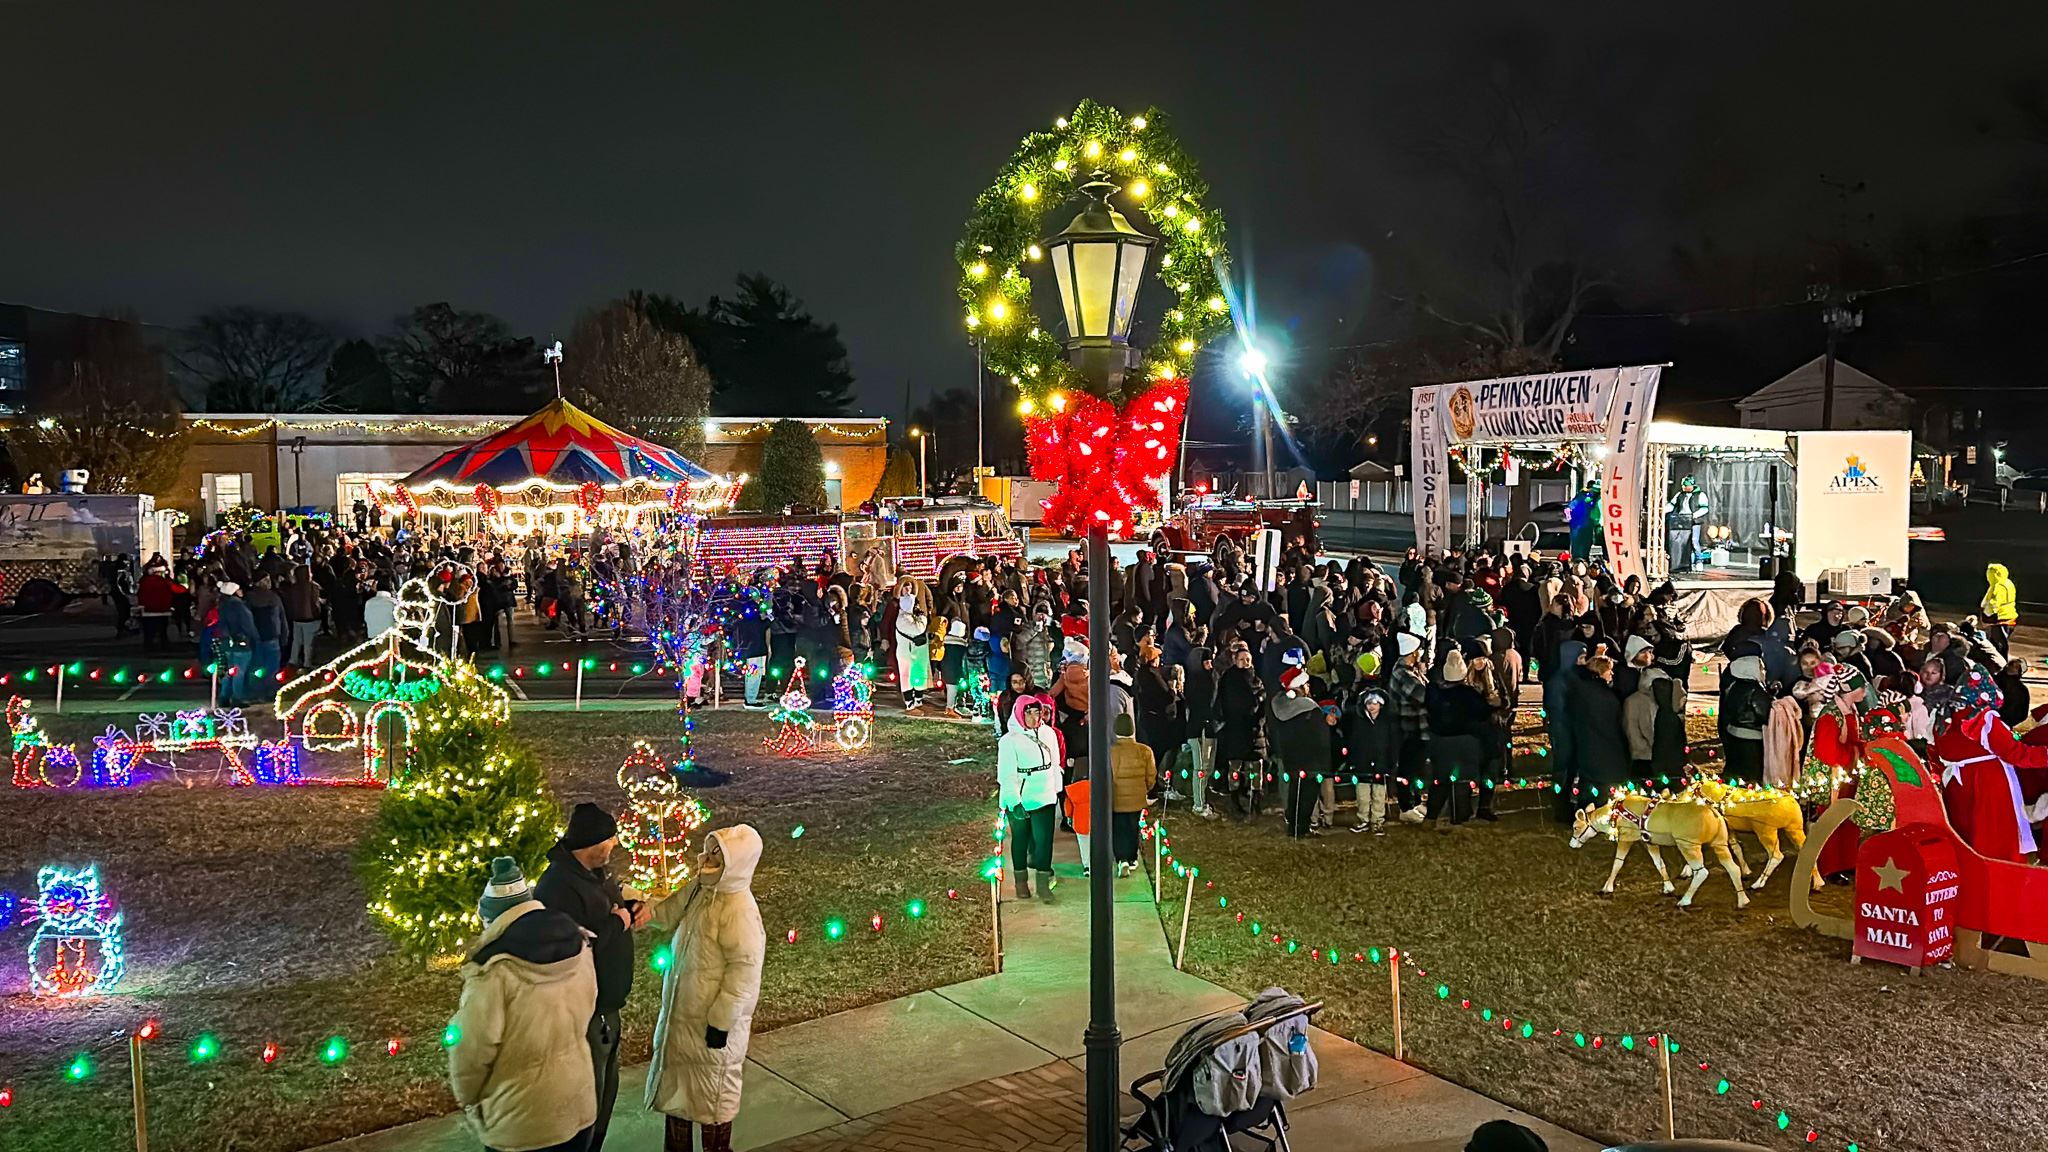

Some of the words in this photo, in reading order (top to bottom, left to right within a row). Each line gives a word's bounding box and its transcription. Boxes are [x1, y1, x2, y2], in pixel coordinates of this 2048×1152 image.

[1480, 376, 1592, 410] PENNSAUKEN
[1480, 409, 1565, 436] TOWNSHIP
[1419, 409, 1437, 557] PENNSAUKE
[1829, 475, 1879, 487] APEX
[1608, 466, 1626, 588] LIGHTIN
[1925, 885, 1958, 905] LETTERS
[1861, 902, 1919, 926] SANTA
[1933, 907, 1944, 921] TO
[1867, 927, 1912, 950] MAIL
[1928, 925, 1949, 944] SANTA
